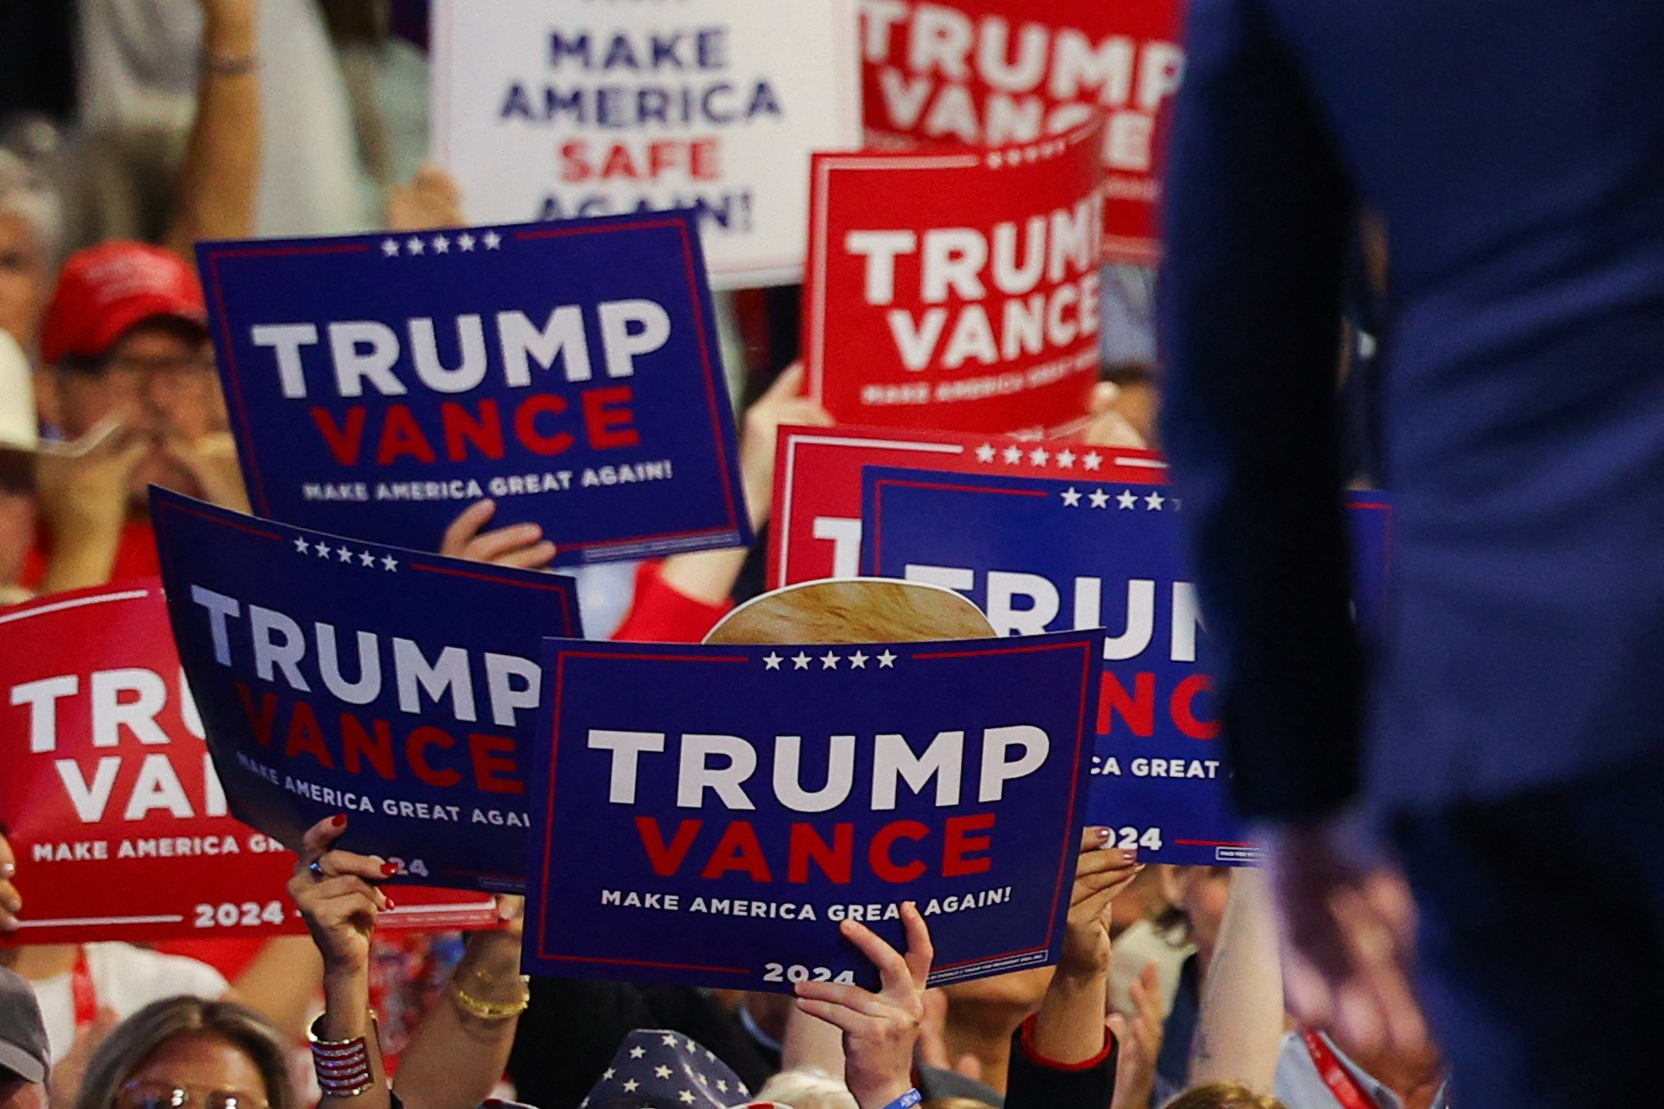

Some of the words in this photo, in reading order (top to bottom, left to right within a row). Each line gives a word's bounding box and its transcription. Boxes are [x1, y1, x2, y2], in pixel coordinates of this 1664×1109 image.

[549, 25, 729, 72] MAKE
[498, 79, 783, 128] AMERICA
[559, 136, 723, 183] SAFE
[537, 191, 752, 234] AN!
[886, 270, 1100, 371] VANCE
[251, 299, 671, 399] TRUMP
[309, 386, 641, 467] VANCE
[303, 483, 368, 503] MAKE
[376, 479, 486, 502] AMERICA
[490, 470, 573, 497] GREAT
[582, 460, 673, 487] AGAIN!
[191, 584, 542, 727] TRUMP
[235, 682, 525, 794] VANCE
[236, 751, 280, 786] MAKE
[284, 775, 374, 813] AMERICA
[382, 799, 460, 822] GREAT
[587, 725, 1051, 813] TRUMP
[1131, 757, 1220, 779] GREAT
[33, 840, 107, 861] MAKE
[117, 835, 240, 858] AMERICA
[633, 813, 996, 884] VANCE
[193, 901, 285, 928] 2024
[601, 888, 679, 911] MAKE
[690, 897, 816, 921] AMERICA
[925, 887, 1012, 916] AGAIN!
[762, 962, 856, 985] 2024
